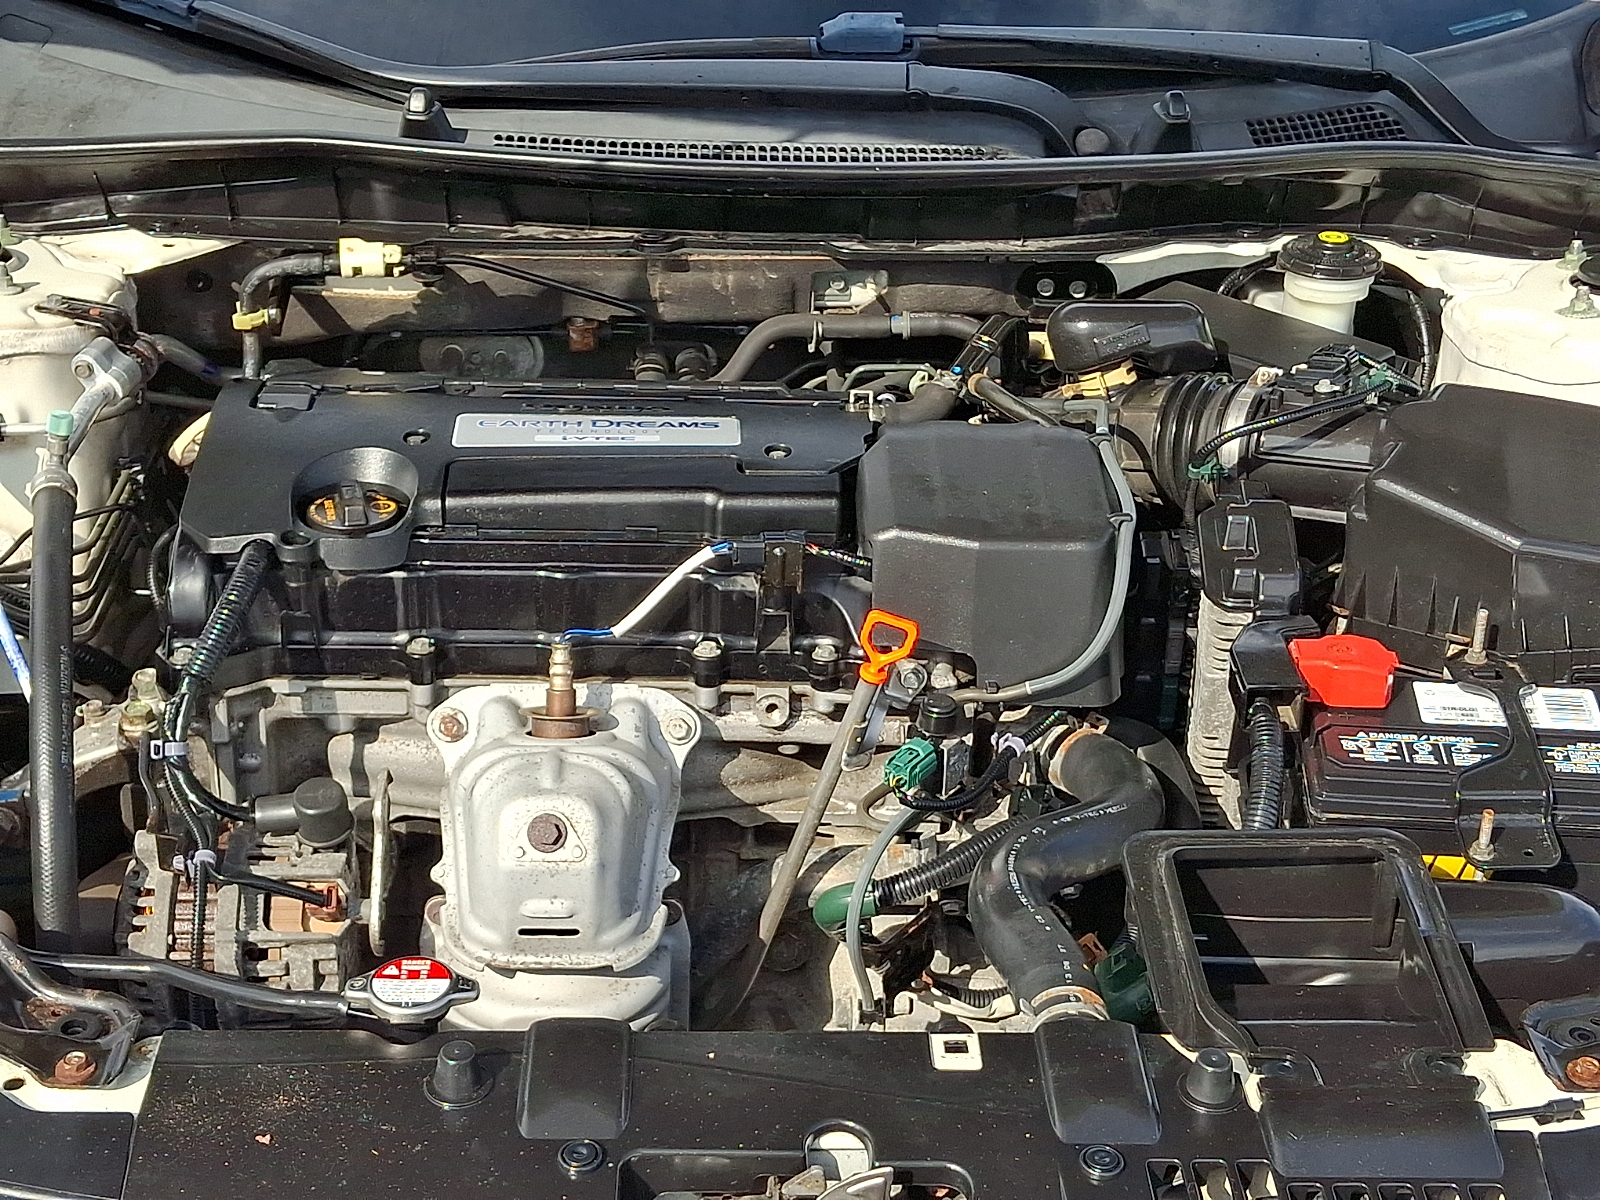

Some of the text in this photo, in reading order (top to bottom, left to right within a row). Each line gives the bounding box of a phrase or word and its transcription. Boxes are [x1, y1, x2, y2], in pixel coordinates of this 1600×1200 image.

[477, 419, 720, 428] EARTH DREAMS
[1368, 732, 1418, 741] DANGER
[1429, 735, 1474, 743] POISON
